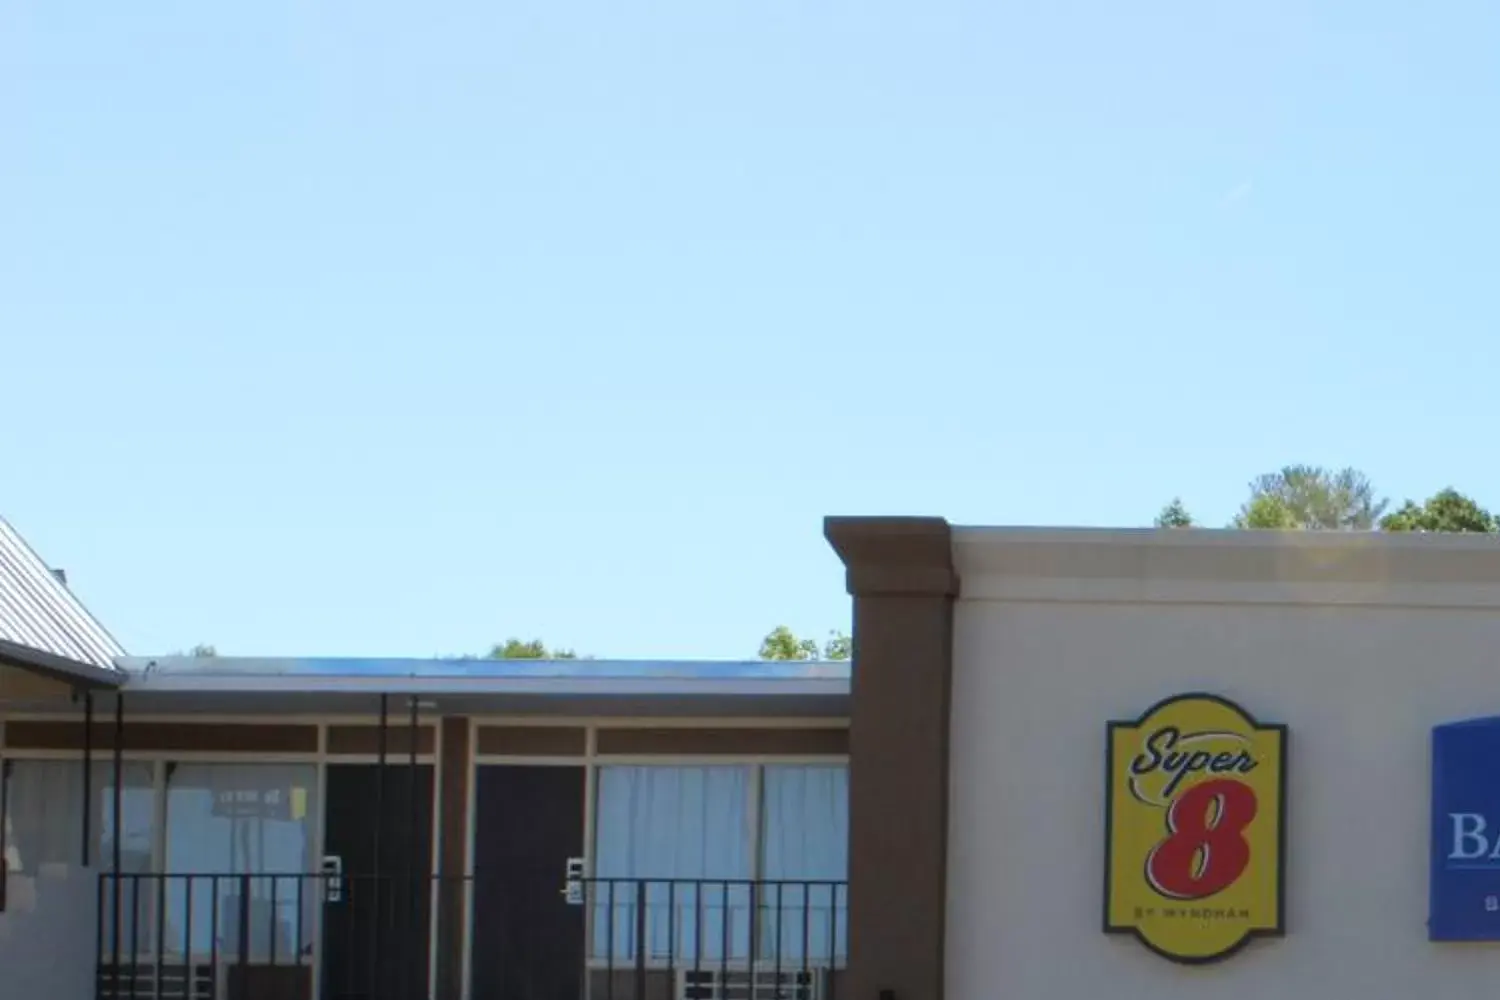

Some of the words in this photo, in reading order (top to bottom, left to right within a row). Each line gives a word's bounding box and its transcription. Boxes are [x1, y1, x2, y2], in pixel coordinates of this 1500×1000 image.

[1130, 726, 1259, 798] Super
[1144, 779, 1258, 901] 8
[1134, 905, 1155, 919] BY
